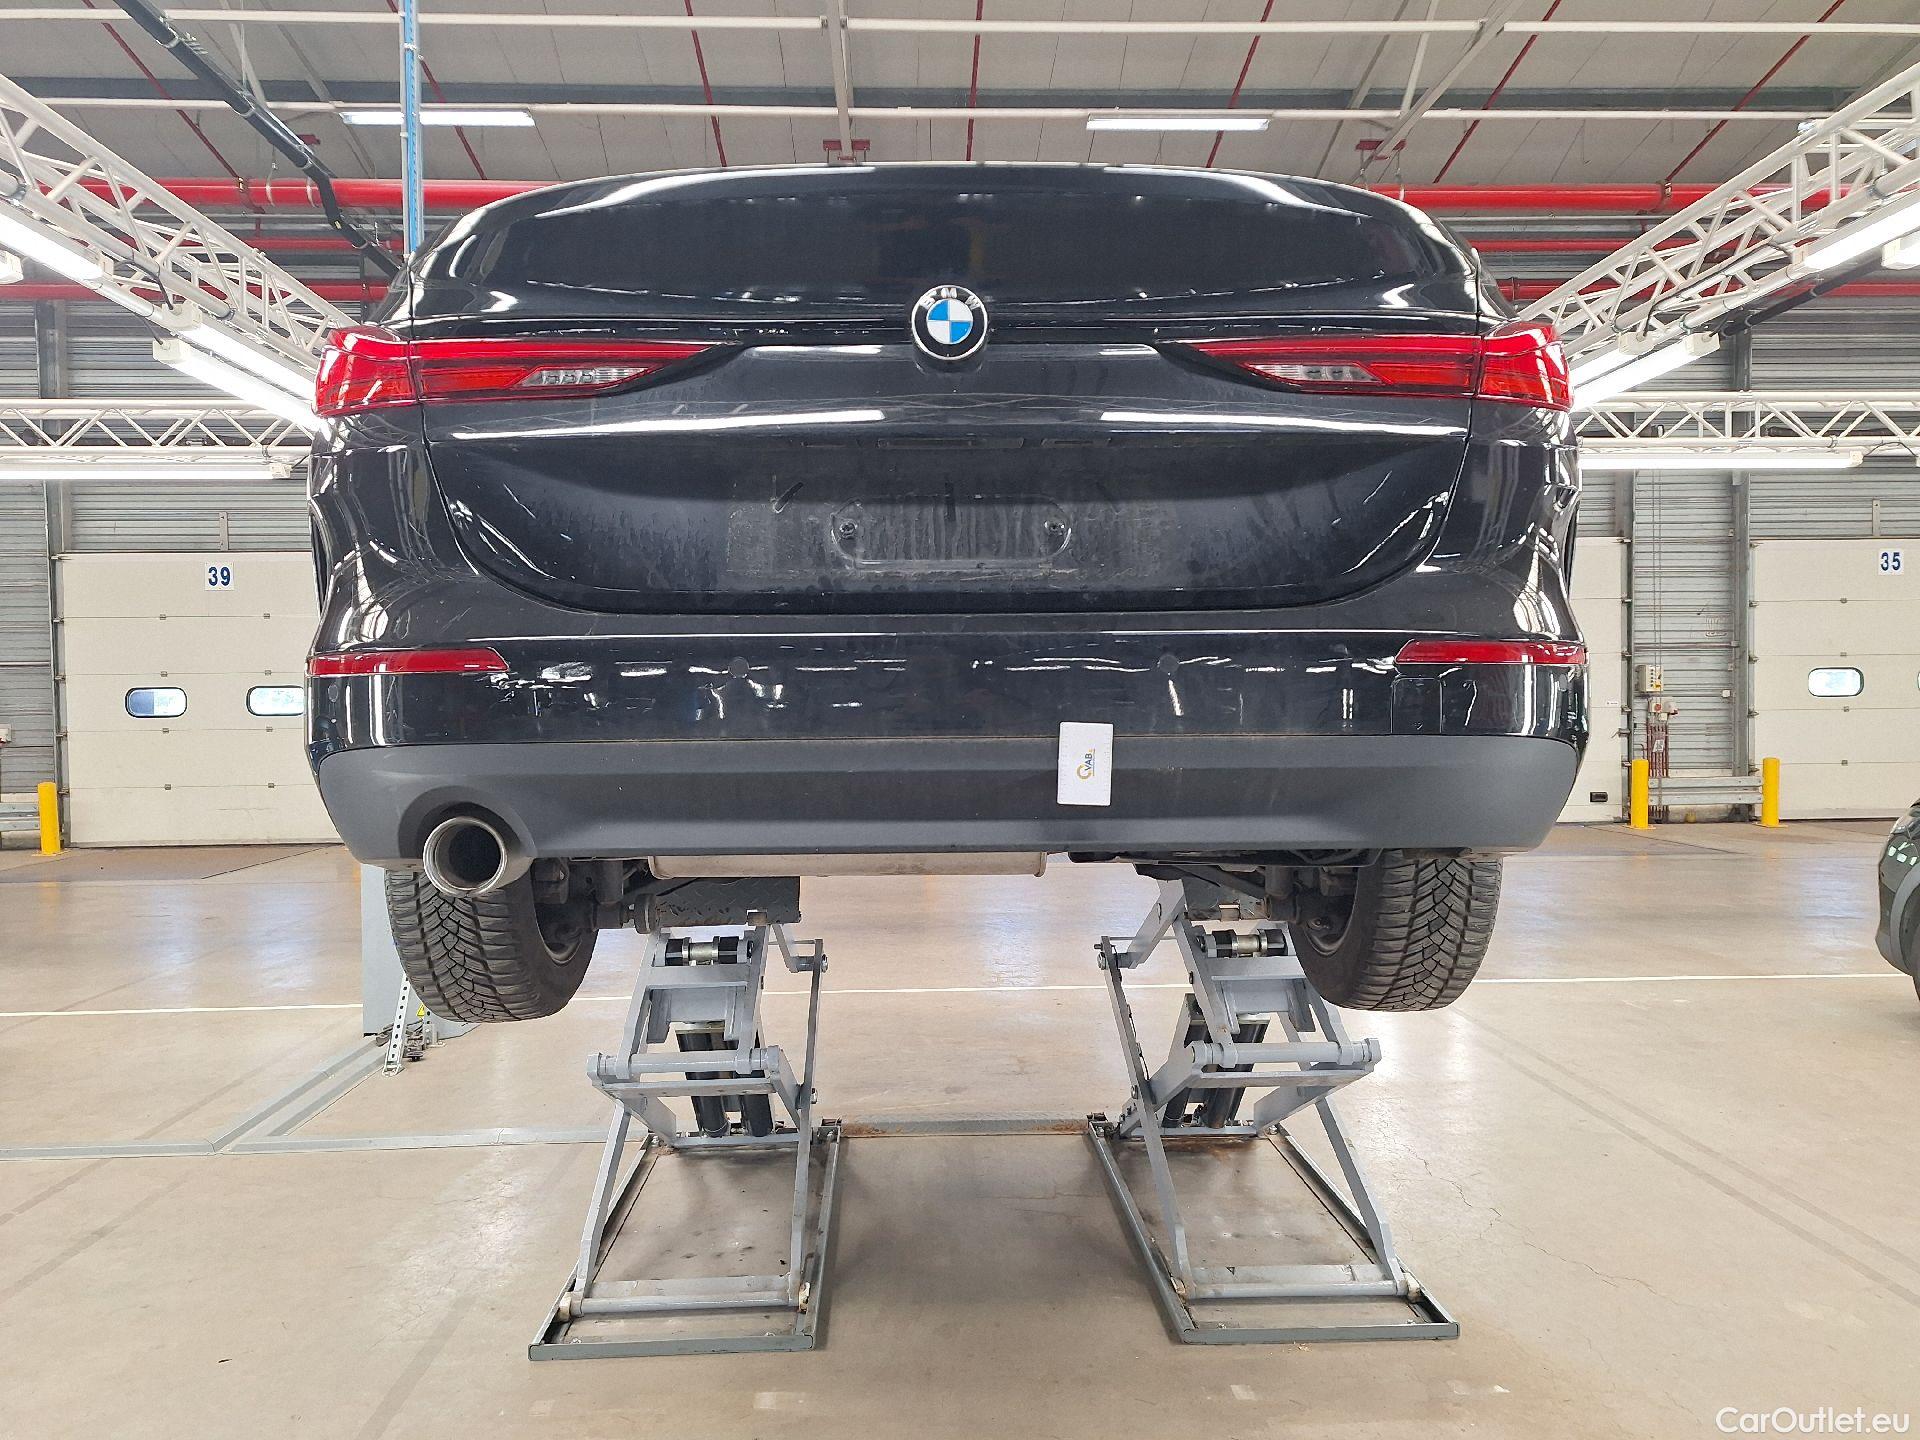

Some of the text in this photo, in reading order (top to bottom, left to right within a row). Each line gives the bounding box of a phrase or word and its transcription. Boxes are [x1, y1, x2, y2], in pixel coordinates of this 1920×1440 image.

[919, 287, 981, 310] BMW
[1880, 551, 1901, 571] 35
[208, 566, 231, 586] 39
